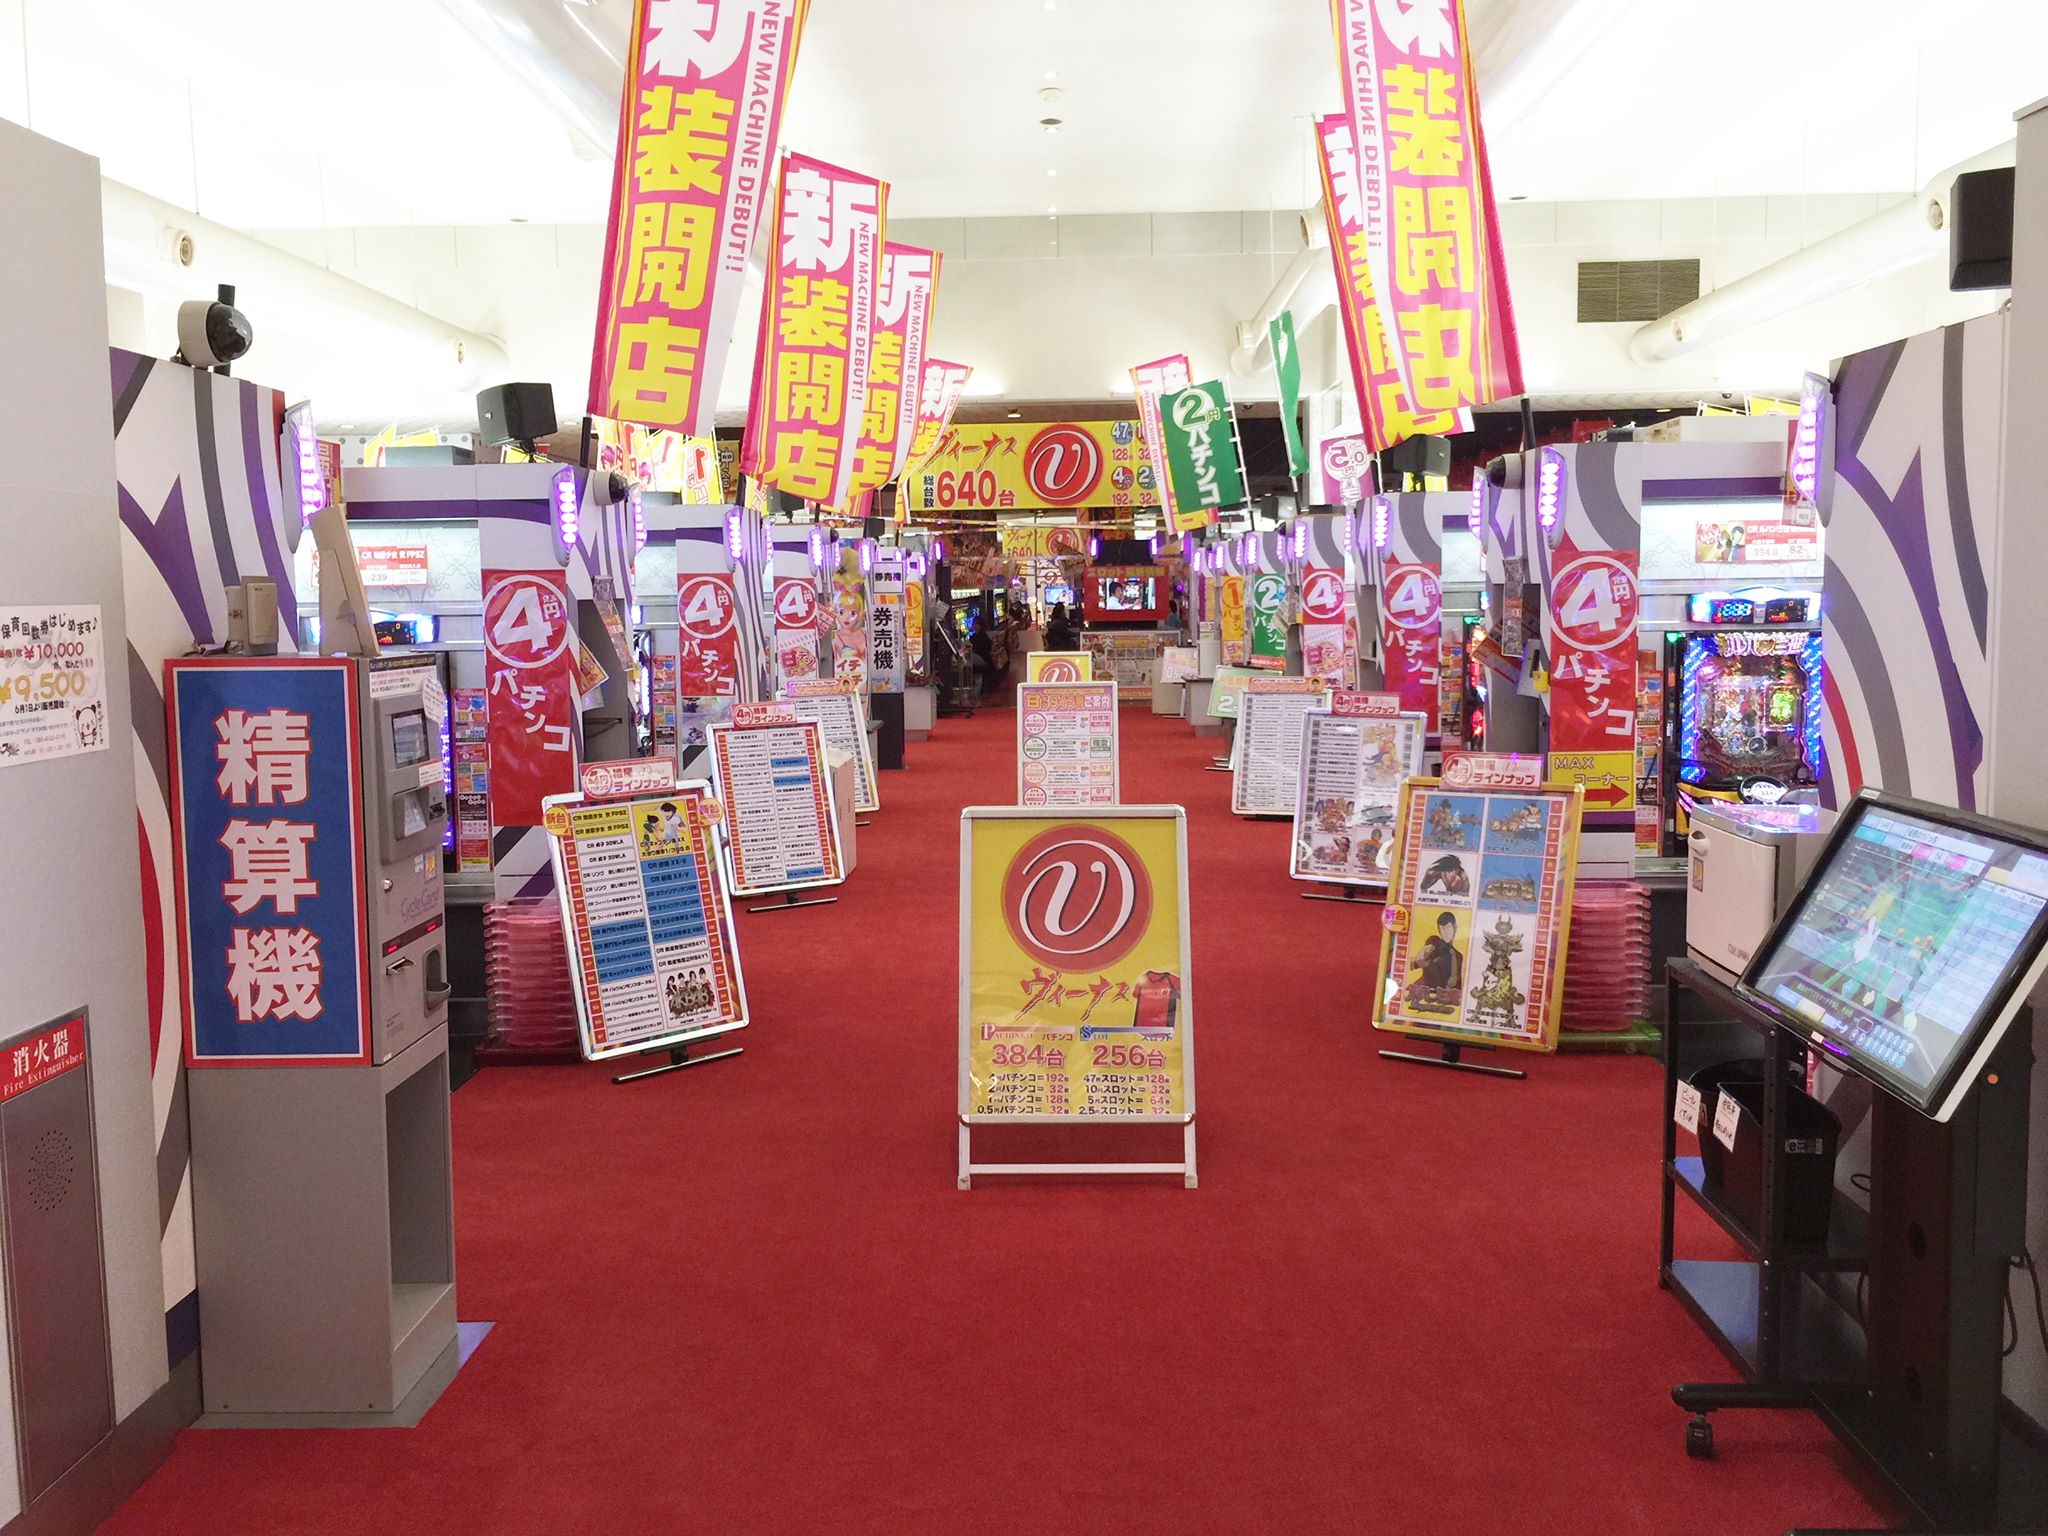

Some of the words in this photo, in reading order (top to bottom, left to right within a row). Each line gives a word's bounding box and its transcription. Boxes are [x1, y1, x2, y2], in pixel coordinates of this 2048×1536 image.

[757, 1, 780, 56] NEW
[740, 61, 773, 168] MACHINE
[724, 175, 756, 272] DEBUT!!
[858, 222, 870, 255] NEW
[857, 260, 869, 333] MACHINE
[914, 285, 924, 311] NEW
[766, 167, 877, 500] 新装開店
[908, 314, 921, 372] MACHINE
[852, 337, 866, 401] DEBUT!!
[904, 374, 916, 424] DEBUT!!
[918, 428, 1017, 473] ヴィーナス
[1188, 426, 1221, 506] パチンコ
[923, 475, 935, 508] 総台数
[937, 470, 1015, 508] 640台
[873, 607, 894, 670] 券売機
[1386, 630, 1438, 685] パチンコ
[682, 640, 735, 695] パチンコ
[490, 669, 570, 752] パチンコ
[754, 713, 793, 723] ラインナップ
[1553, 652, 1634, 736] パチンコ
[614, 775, 669, 791] ラインナップ
[1473, 773, 1534, 784] ラインナップ
[1555, 757, 1594, 769] MAX
[1573, 772, 1629, 786] コーナー
[213, 708, 325, 1024] 精算機
[1014, 967, 1131, 1022] ヴィーナス
[13, 1029, 69, 1077] 消火器
[991, 1043, 1064, 1067] 384台
[1092, 1044, 1164, 1068] 256台
[1042, 1033, 1073, 1041] パチンコ
[3, 1080, 25, 1096] Fire
[27, 1051, 84, 1085] Extinguisher
